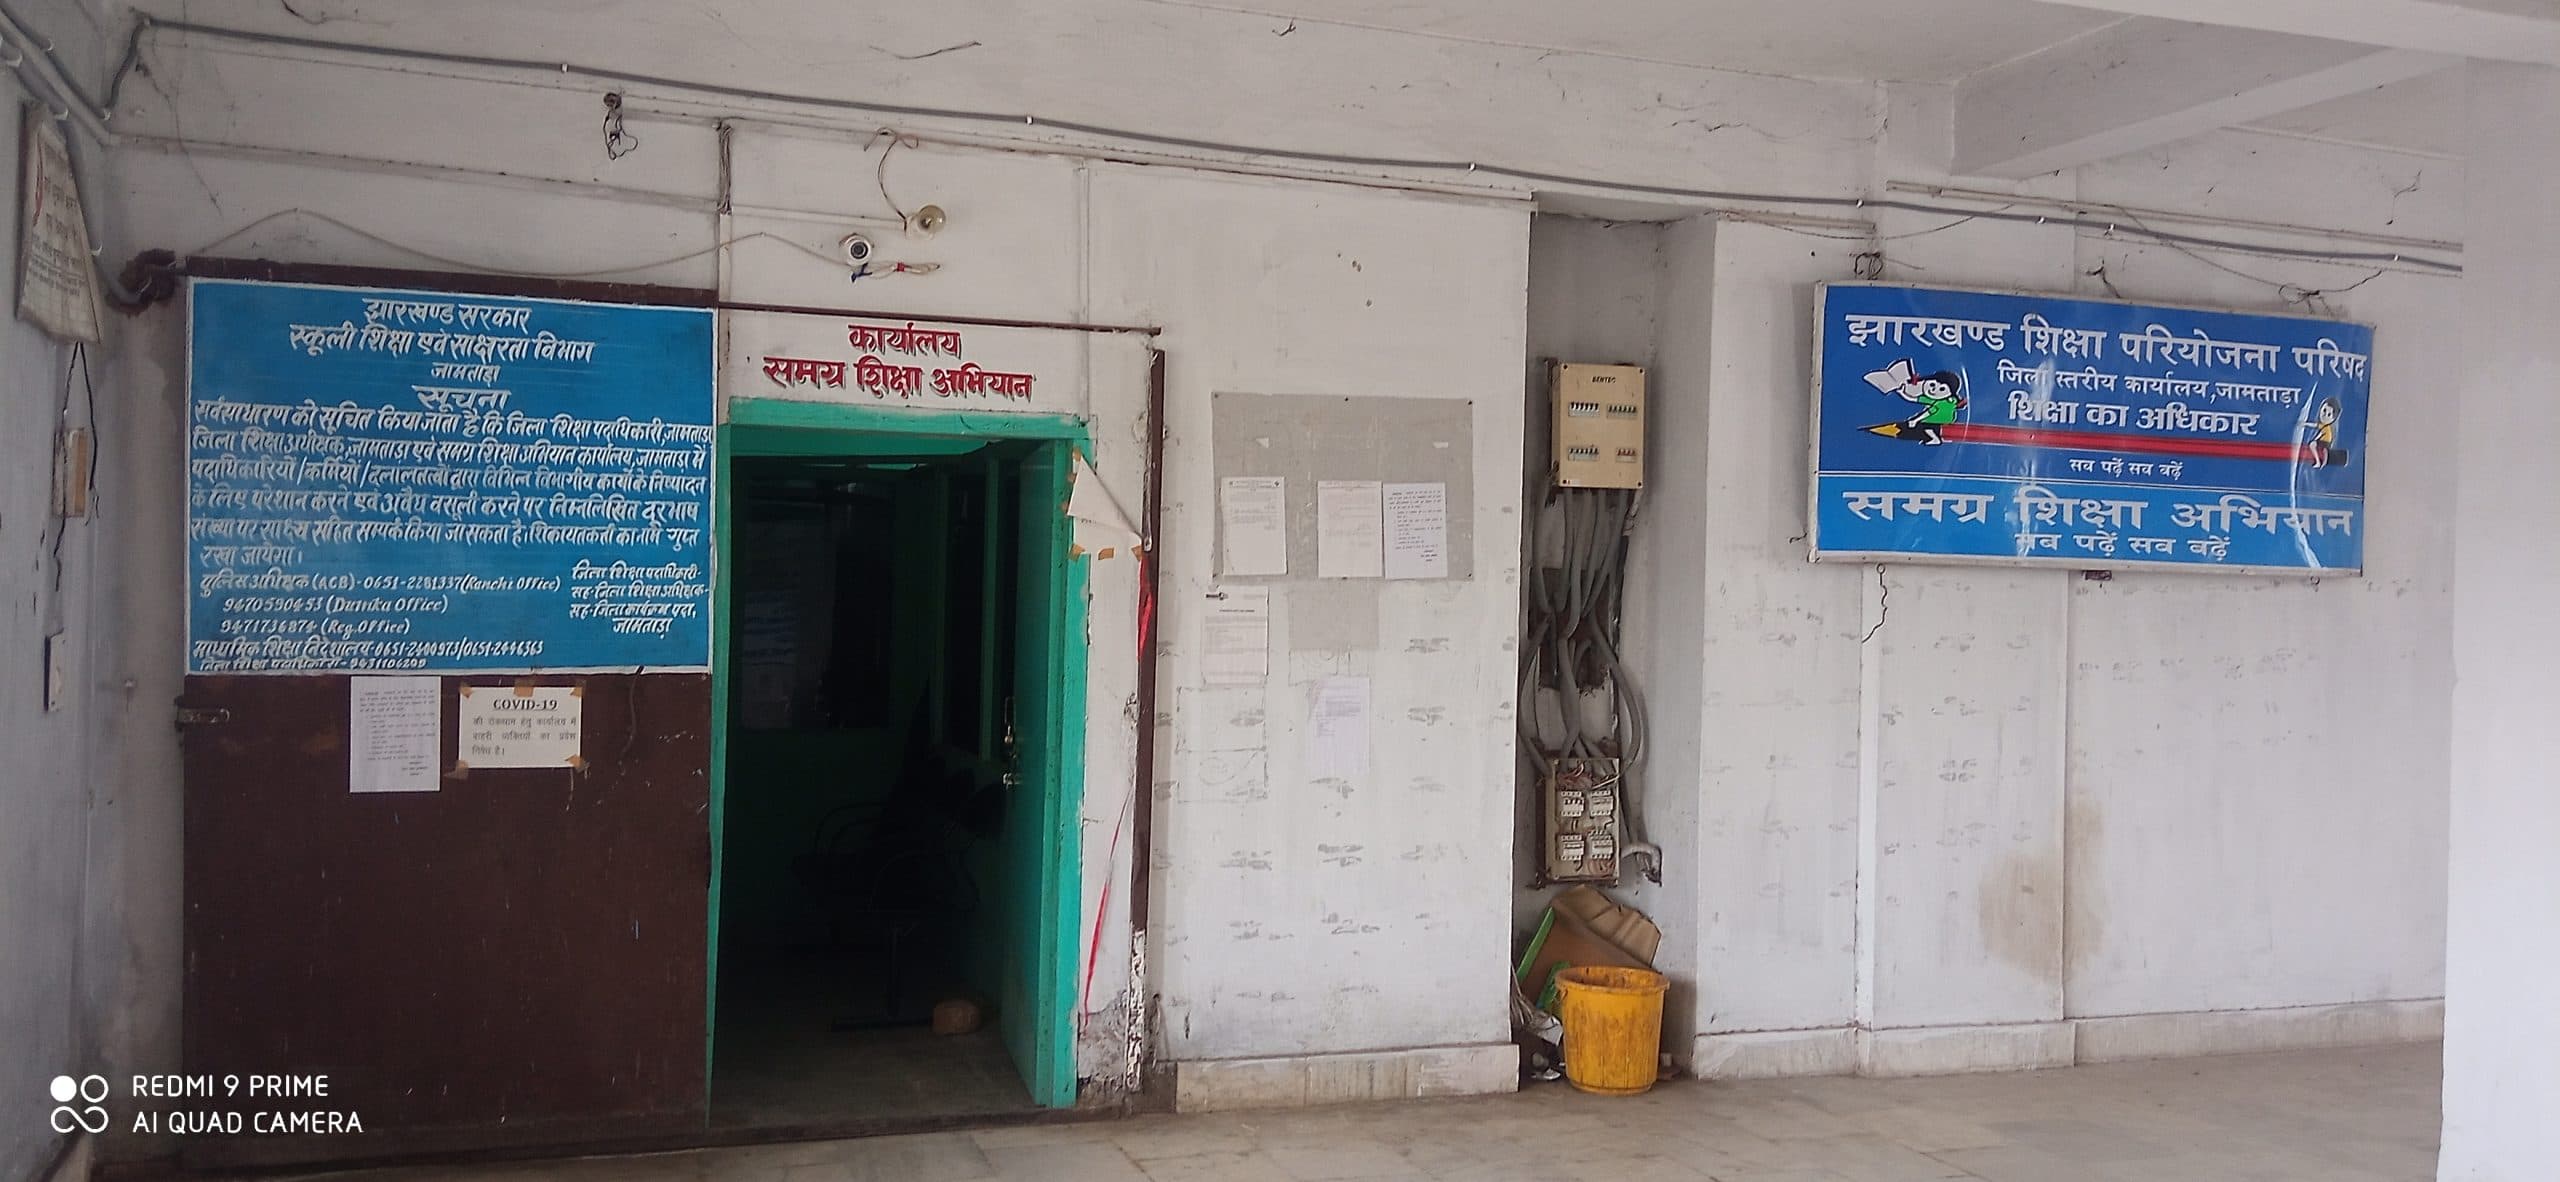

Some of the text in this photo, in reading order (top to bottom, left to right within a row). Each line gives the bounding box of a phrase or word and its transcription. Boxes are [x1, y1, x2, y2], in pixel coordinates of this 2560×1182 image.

[363, 298, 533, 334] झारखण्ड सरकार
[289, 320, 358, 357] स्कूली
[359, 324, 416, 358] शिक्षा
[450, 334, 531, 364] साक्षरता
[532, 331, 596, 363] विभाग
[847, 321, 961, 359] कार्यालय
[1845, 312, 2367, 383] झारखण्ड शिक्षा परियोजना परिषद
[431, 362, 501, 387] जामताड़ा
[763, 355, 1036, 402] समग्र शिक्षा अभियान
[1997, 359, 2048, 386] जिला
[2056, 365, 2117, 392] स्तरीय
[411, 385, 512, 412] सूचना
[2008, 390, 2261, 435] शिक्षा का अधिकार
[292, 398, 319, 427] को
[319, 400, 376, 435] सूचित
[378, 404, 422, 431] किया
[421, 411, 461, 433] जाता
[462, 408, 482, 438] है
[481, 411, 504, 435] कि
[506, 410, 548, 437] जिला
[550, 413, 594, 443] शिक्षा
[192, 425, 239, 450] जिला
[240, 425, 286, 454] शिक्षा
[437, 440, 476, 464] समग्र
[477, 436, 520, 465] शिक्षा
[518, 439, 579, 464] अभियान
[692, 443, 707, 470] में
[449, 466, 481, 490] द्वारा
[481, 463, 532, 490] विभिन्न
[534, 465, 598, 493] विभागीय
[649, 470, 708, 497] निष्पादन
[2069, 458, 2096, 473] सब
[2128, 461, 2154, 476] सब
[207, 481, 248, 510] लिए
[251, 483, 308, 512] परेशान
[311, 484, 351, 514] करने
[380, 485, 431, 515] अवैध
[430, 489, 480, 521] वसूली
[480, 491, 520, 518] करने
[522, 495, 548, 519] पर
[549, 492, 641, 522] निम्नलिखित
[1843, 485, 2353, 537] समग्र शिक्षा अभियान
[236, 519, 258, 540] पर
[312, 514, 355, 547] सहित
[404, 516, 442, 543] किया
[666, 527, 701, 551] गुप्त
[2015, 533, 2062, 555] सब
[2073, 530, 2118, 557] पढ़ें
[2128, 537, 2176, 554] सब
[571, 559, 608, 580] जिला
[609, 560, 644, 580] शिक्षा
[612, 617, 674, 639] जामताड़ा
[261, 634, 303, 659] शिक्षा
[493, 699, 558, 712] COVID-19
